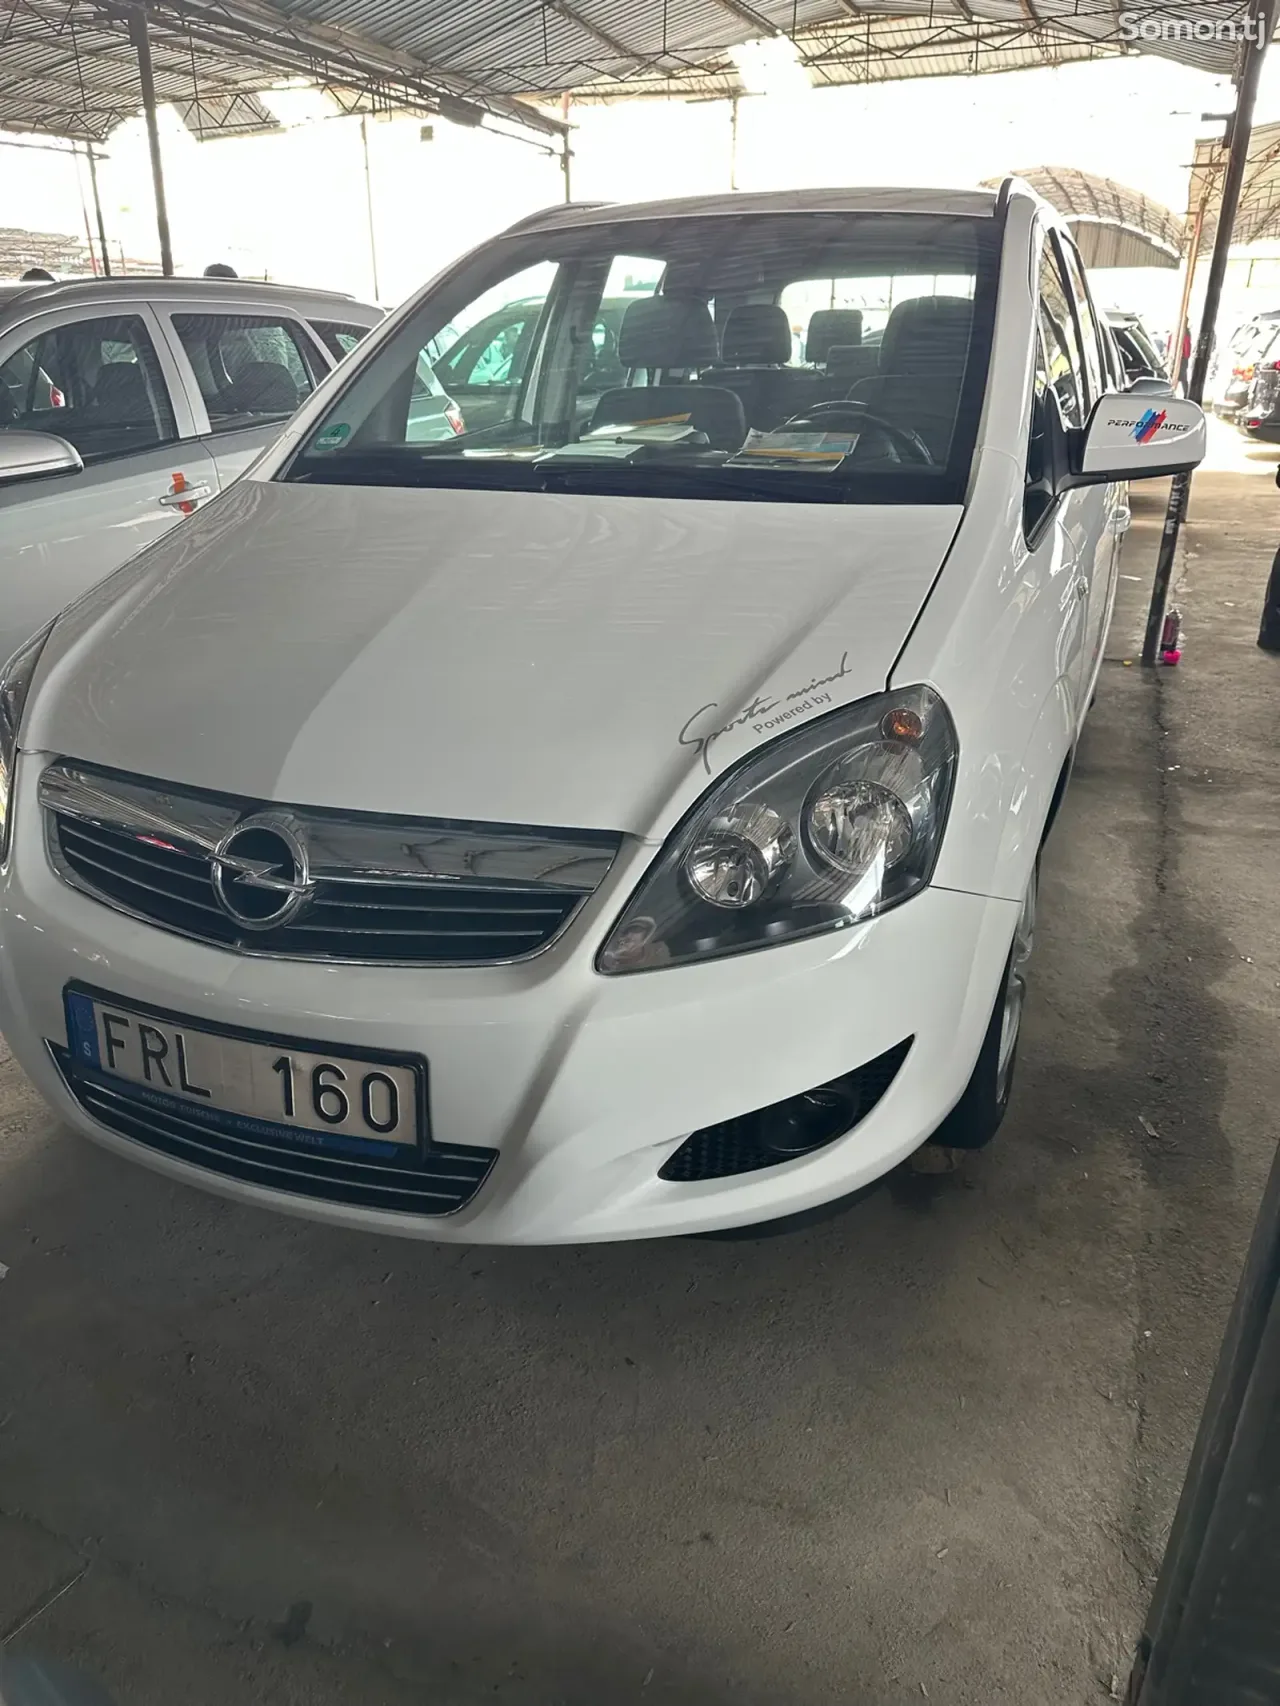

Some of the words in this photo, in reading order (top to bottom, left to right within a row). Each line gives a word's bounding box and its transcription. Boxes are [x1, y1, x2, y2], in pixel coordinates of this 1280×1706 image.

[678, 696, 780, 775] Sports
[786, 651, 852, 701] mind
[752, 700, 813, 734] Powered
[813, 692, 832, 705] by
[83, 1041, 92, 1057] S
[102, 1011, 212, 1099] FRL
[272, 1056, 401, 1134] 160
